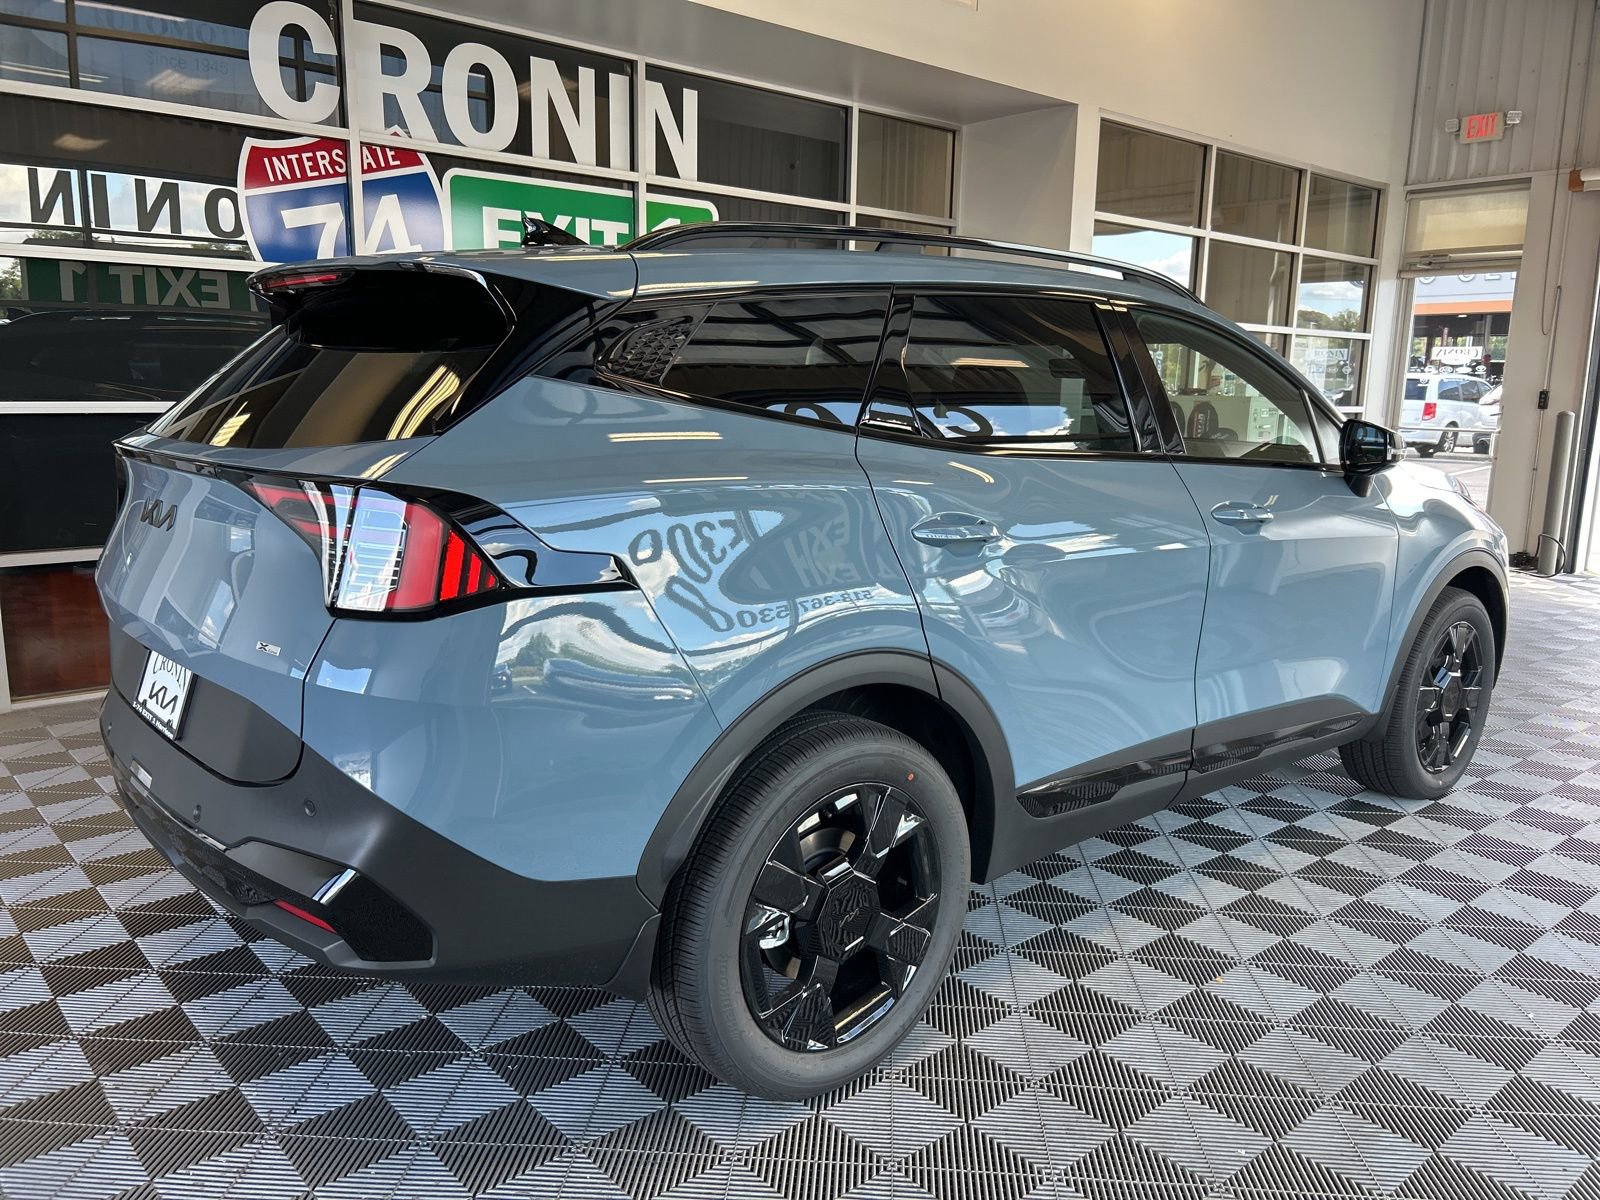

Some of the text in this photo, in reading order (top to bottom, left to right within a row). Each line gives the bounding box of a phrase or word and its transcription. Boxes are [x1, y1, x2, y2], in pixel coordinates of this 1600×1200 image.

[248, 1, 698, 182] CRONIN
[1466, 112, 1498, 139] EXIT
[264, 144, 401, 182] INTERSATE
[281, 194, 423, 260] 74
[140, 496, 178, 531] KIA
[153, 654, 188, 693] CRONIN
[142, 708, 153, 721] EXIT
[148, 680, 179, 715] KIA
